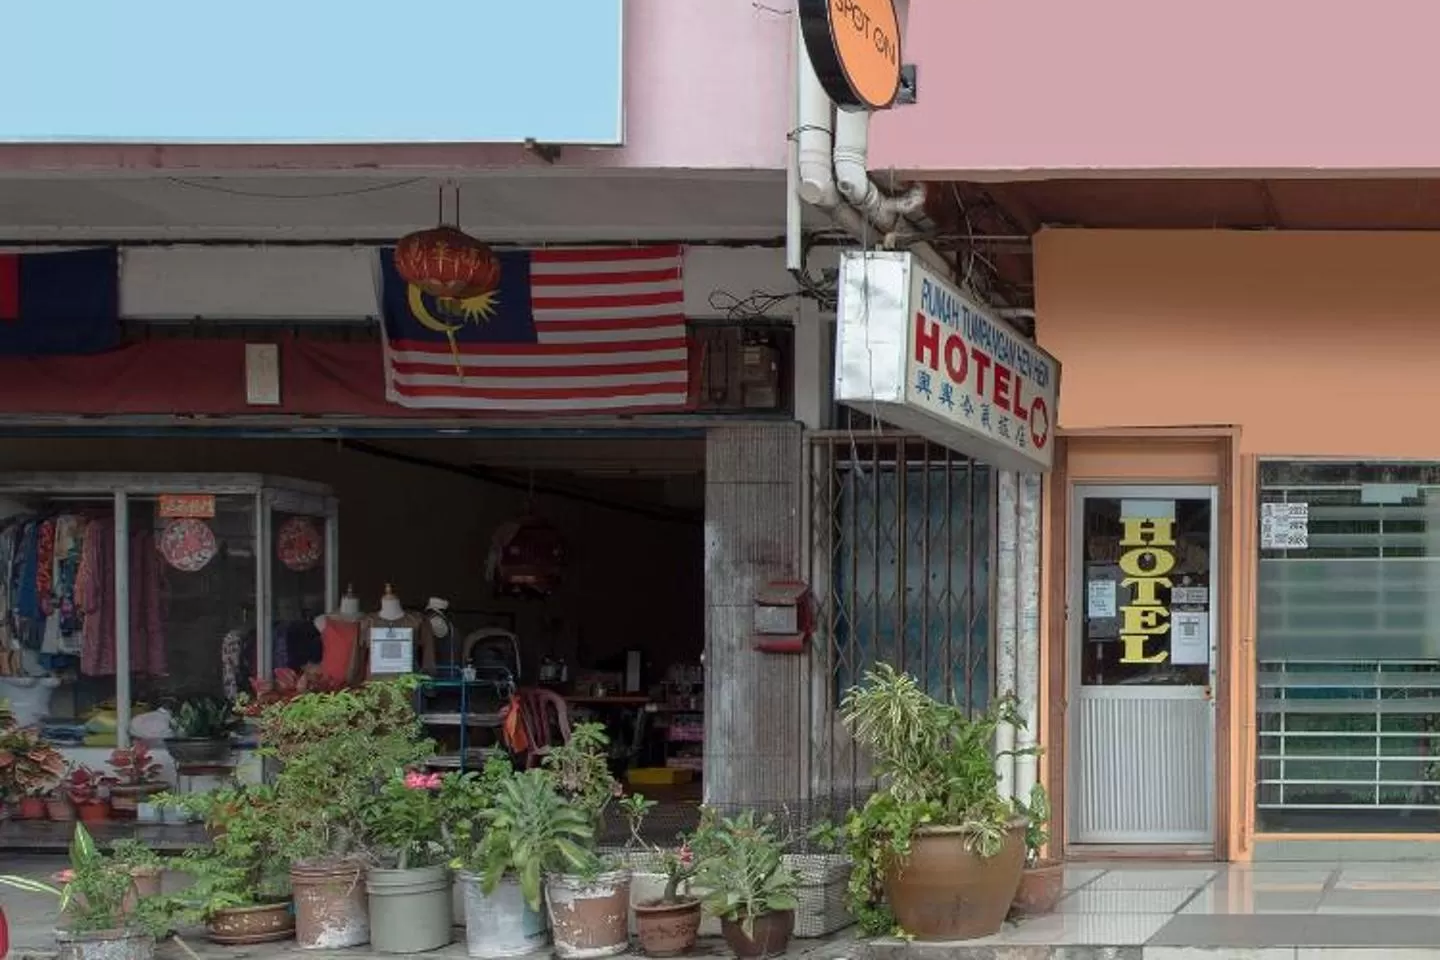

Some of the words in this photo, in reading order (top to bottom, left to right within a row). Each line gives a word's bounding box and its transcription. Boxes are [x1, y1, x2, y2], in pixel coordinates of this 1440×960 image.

[873, 27, 896, 65] ON
[921, 278, 959, 330] RUMAH
[914, 312, 1028, 421] HOTEL
[1118, 516, 1178, 663] HOTEL
